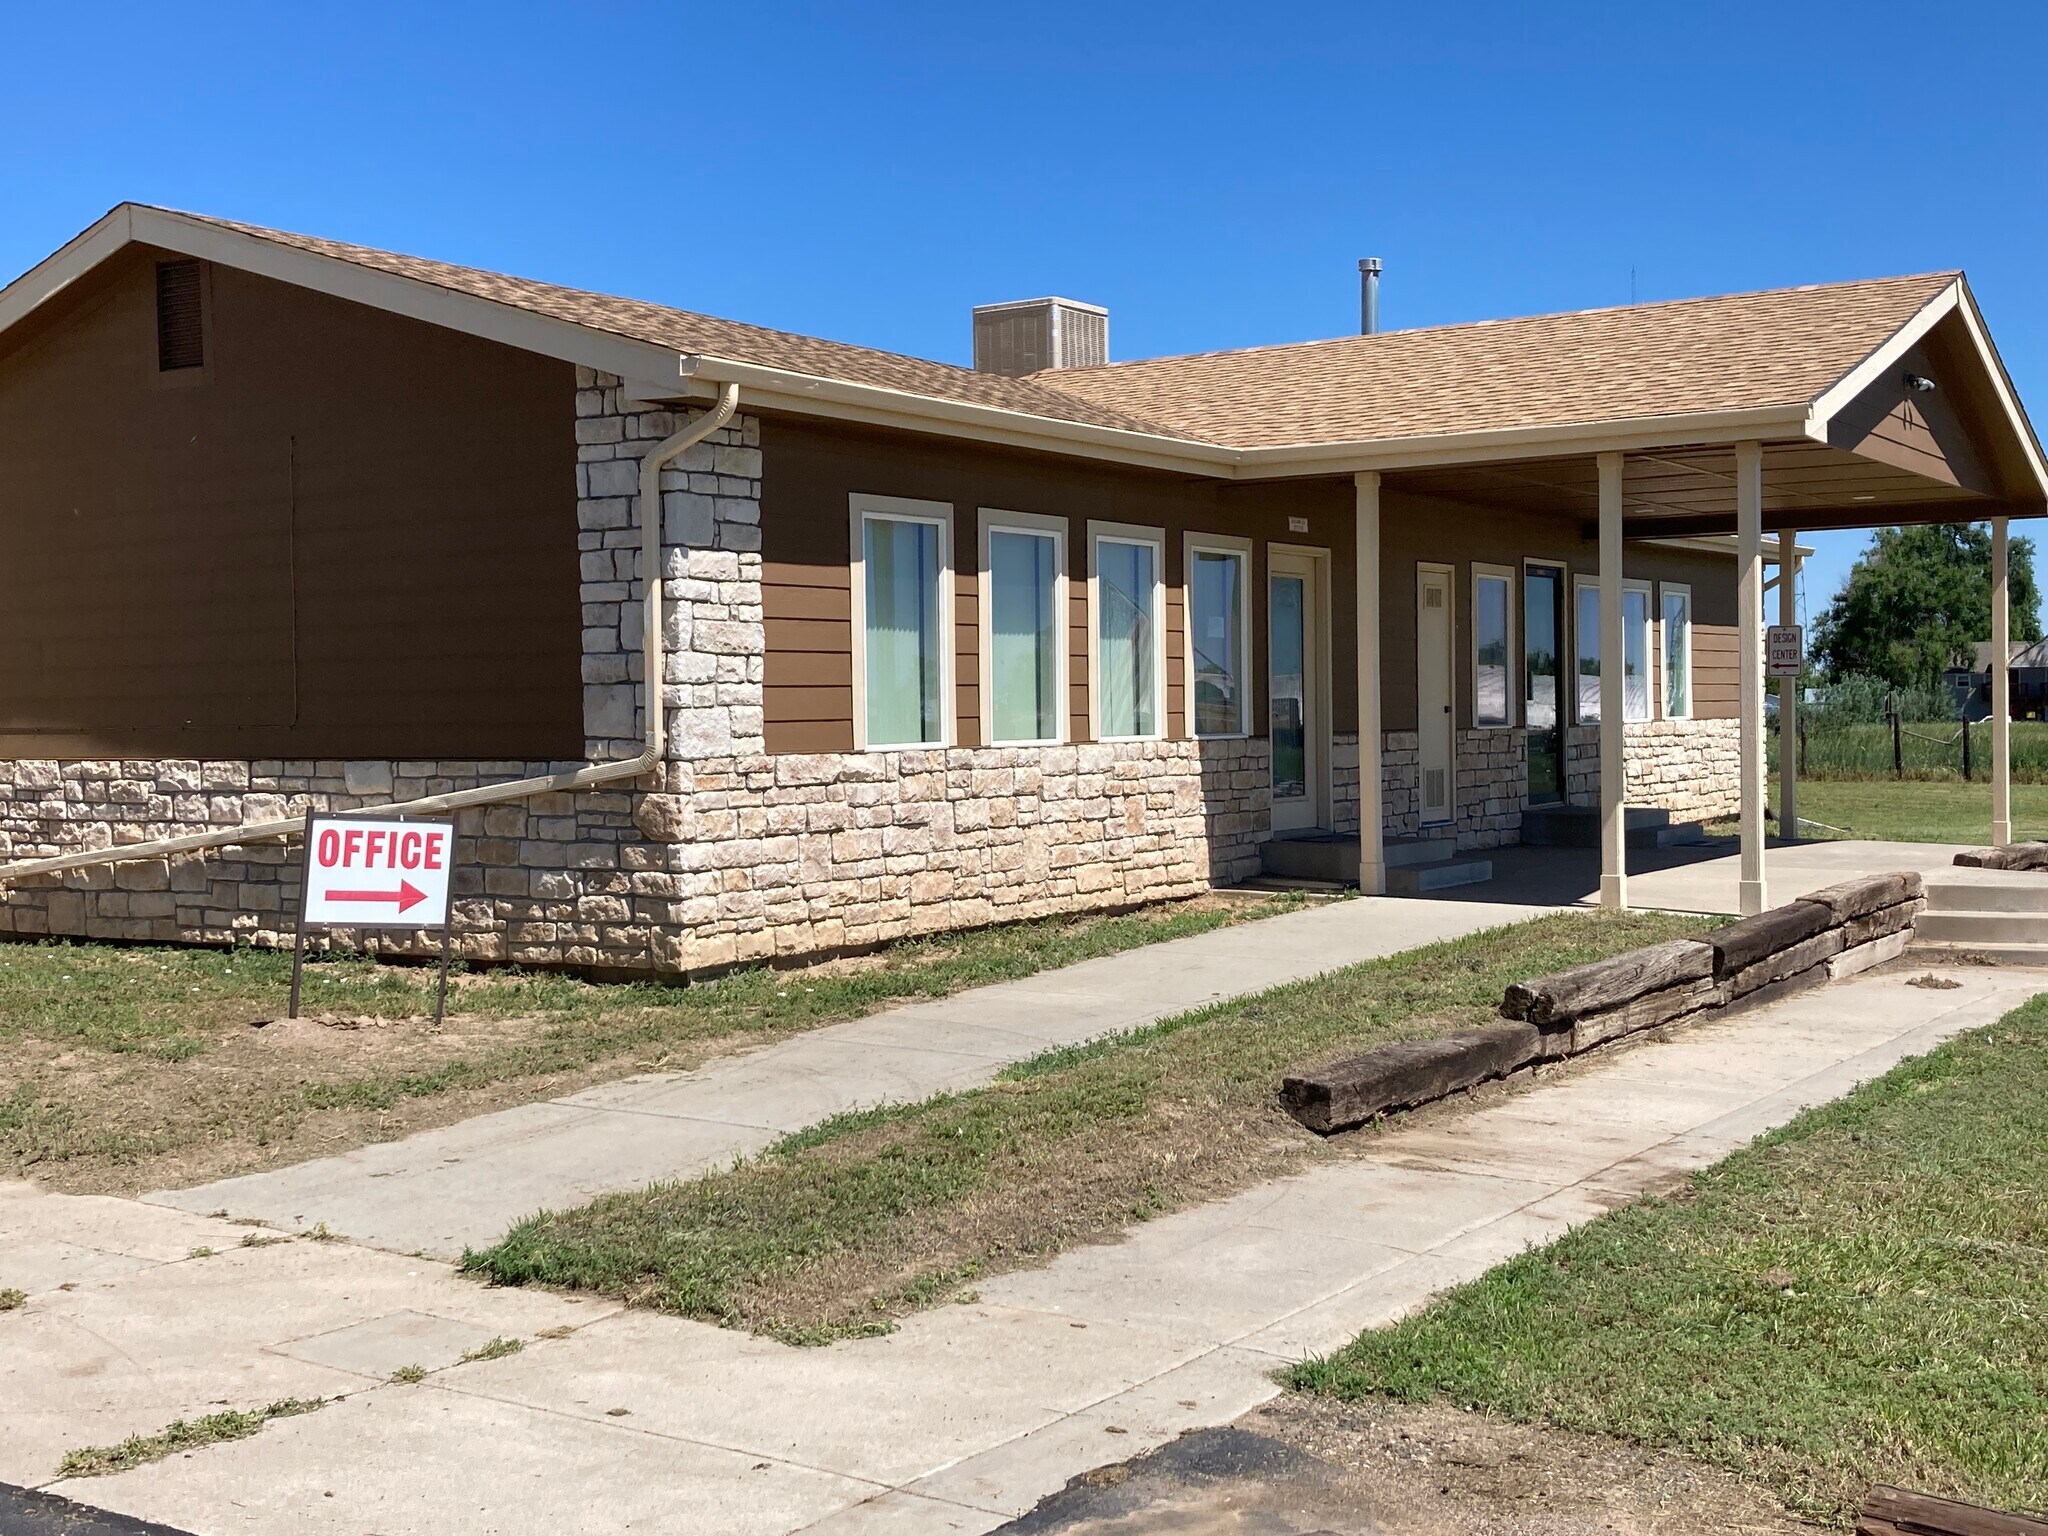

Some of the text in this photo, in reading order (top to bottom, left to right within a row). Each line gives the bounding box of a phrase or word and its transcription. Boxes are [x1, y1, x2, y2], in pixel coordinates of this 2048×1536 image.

[1773, 632, 1797, 643] DESIGN
[1772, 649, 1798, 660] CENTER
[318, 828, 444, 870] OFFICE
